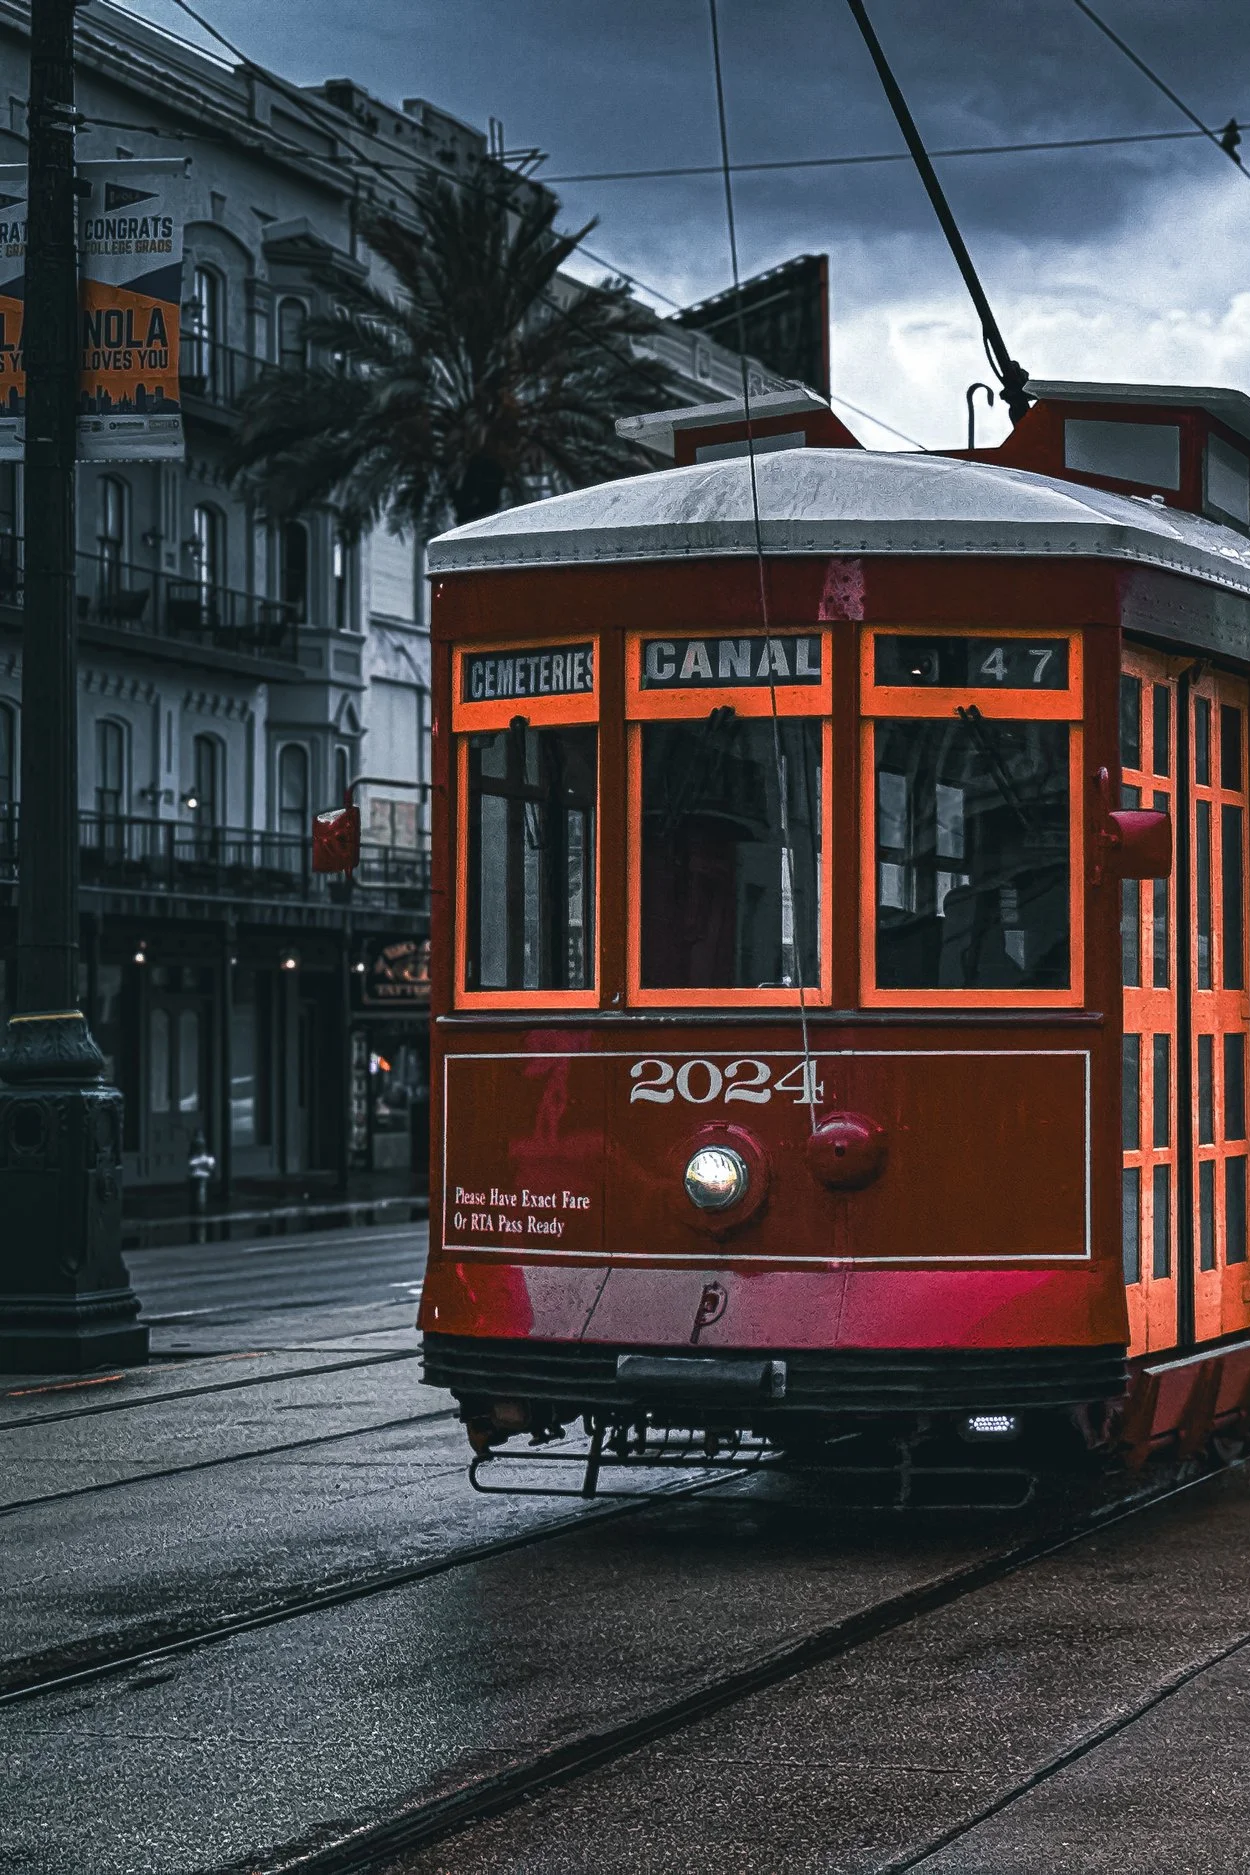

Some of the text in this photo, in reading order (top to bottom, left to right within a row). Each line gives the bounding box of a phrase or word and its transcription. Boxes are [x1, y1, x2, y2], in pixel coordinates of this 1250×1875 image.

[85, 216, 173, 240] CONGRATS
[85, 239, 173, 255] COLLEGE GRADS
[84, 307, 169, 349] NOLA
[82, 349, 169, 371] LOVES YOU
[646, 639, 822, 681] CANAL
[471, 651, 594, 699] CEMETERIES
[630, 1058, 824, 1105] 2024
[455, 1186, 591, 1209] Please Have Exact Fare
[454, 1211, 565, 1237] Or RTA Pass Ready
